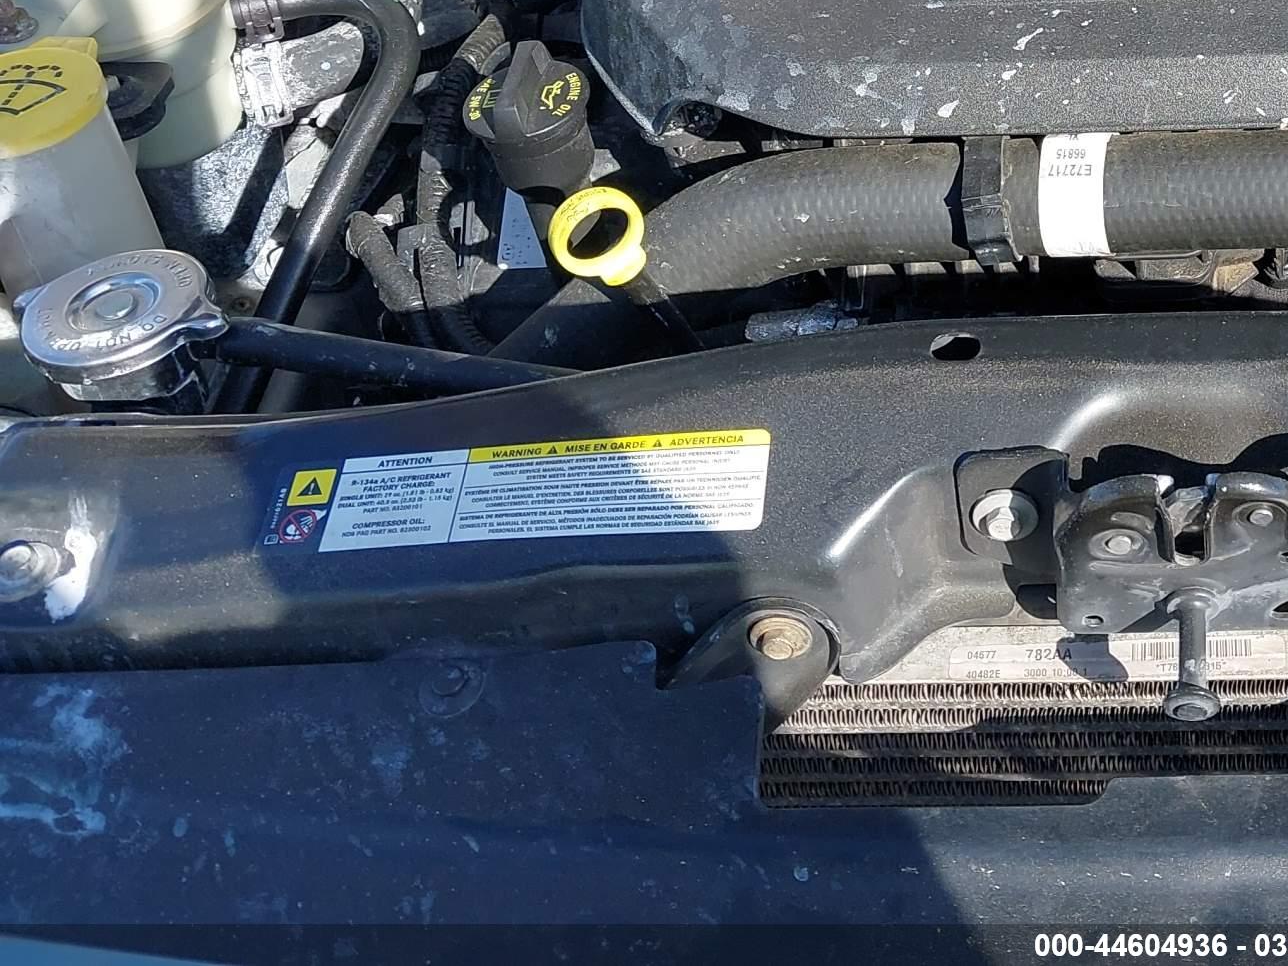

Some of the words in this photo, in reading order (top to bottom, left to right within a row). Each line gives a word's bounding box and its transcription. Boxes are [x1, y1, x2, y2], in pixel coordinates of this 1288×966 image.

[565, 72, 582, 102] ENGINE
[552, 103, 572, 117] OIL
[1048, 164, 1092, 176] E72717
[610, 440, 646, 449] GARDE
[670, 434, 743, 446] ADVERTENCIA
[492, 448, 541, 458] WARNING
[378, 456, 432, 467] ATTENTION
[397, 472, 450, 481] REFRIGERANT
[352, 519, 407, 529] COMPRESSOR
[1026, 648, 1072, 660] 782AA
[1024, 669, 1047, 677] 3000
